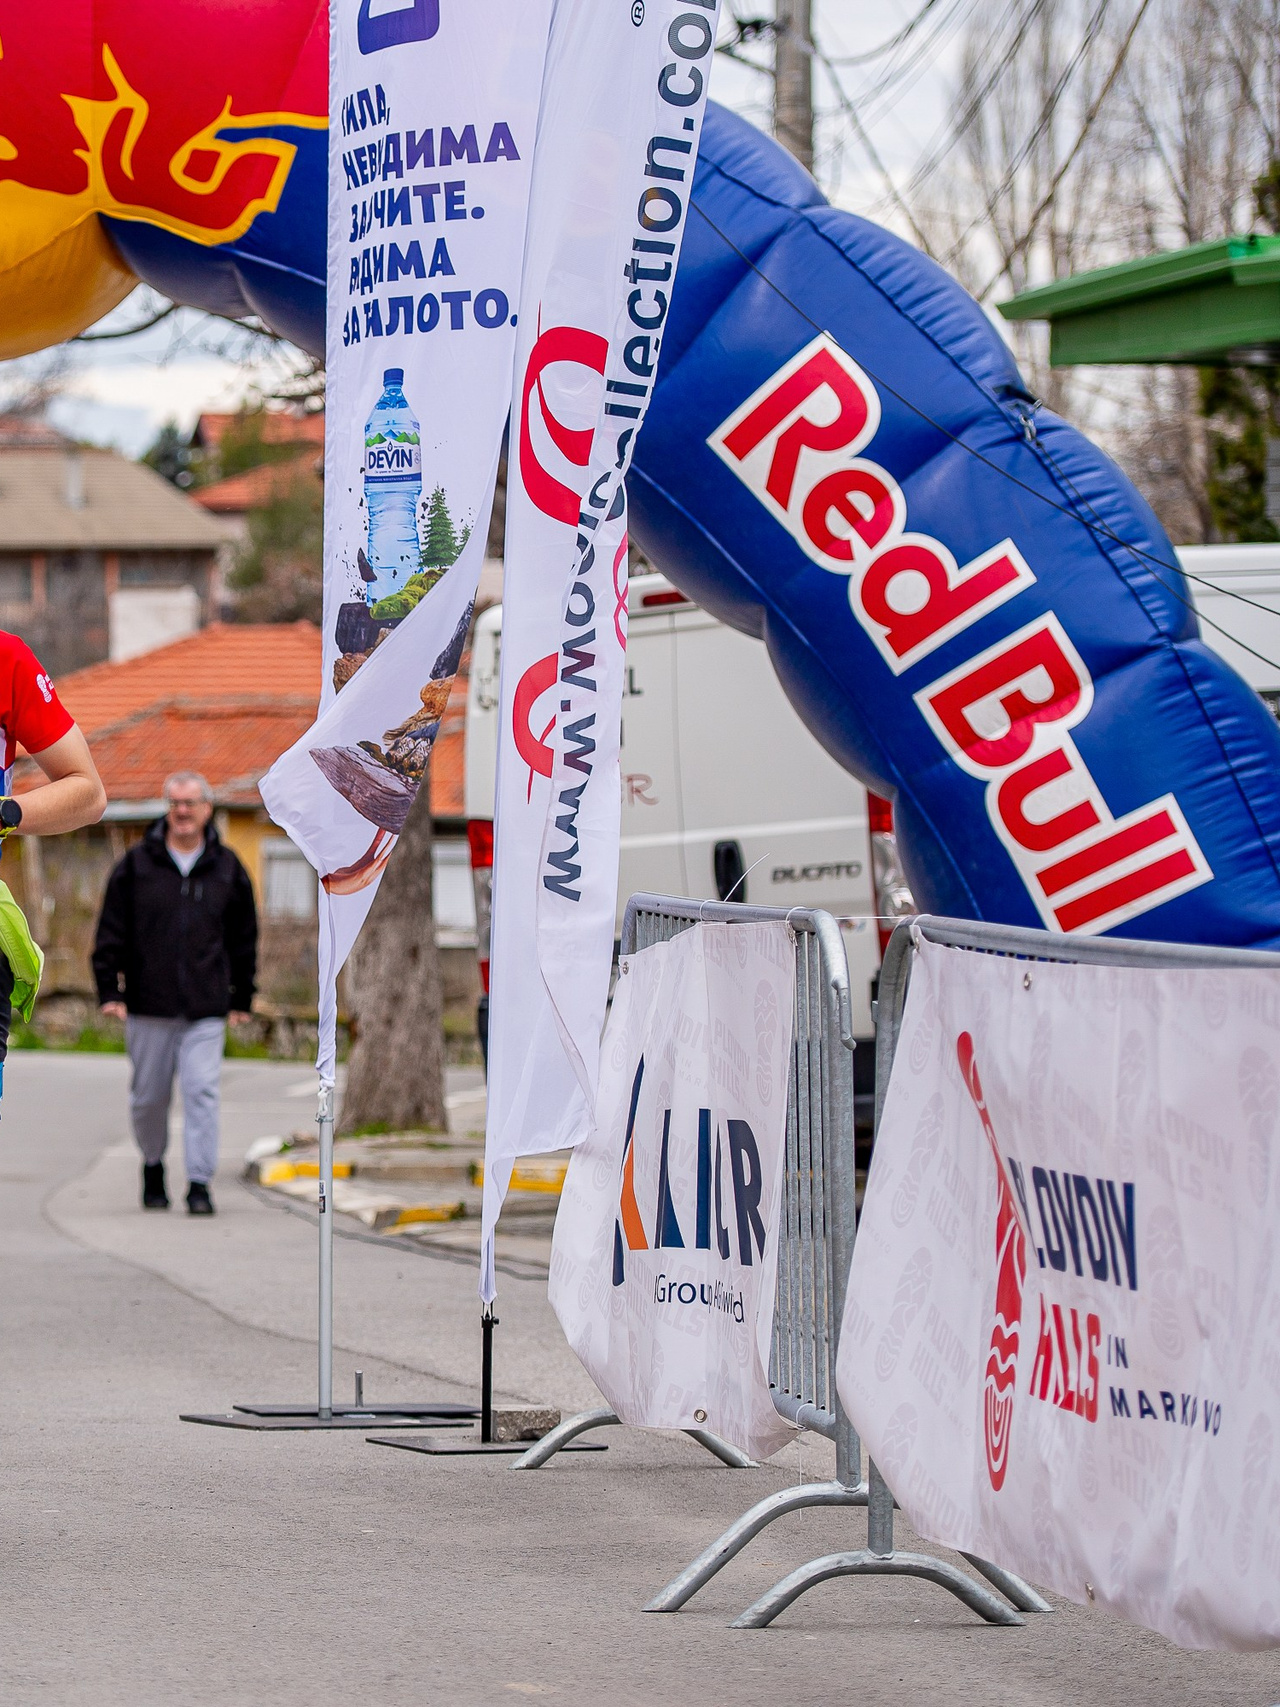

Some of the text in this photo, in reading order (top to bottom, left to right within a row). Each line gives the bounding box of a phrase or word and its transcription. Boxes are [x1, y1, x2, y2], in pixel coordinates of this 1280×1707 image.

[367, 448, 413, 470] DEVIN
[714, 338, 1206, 935] Red Bull
[1107, 1333, 1129, 1369] IN
